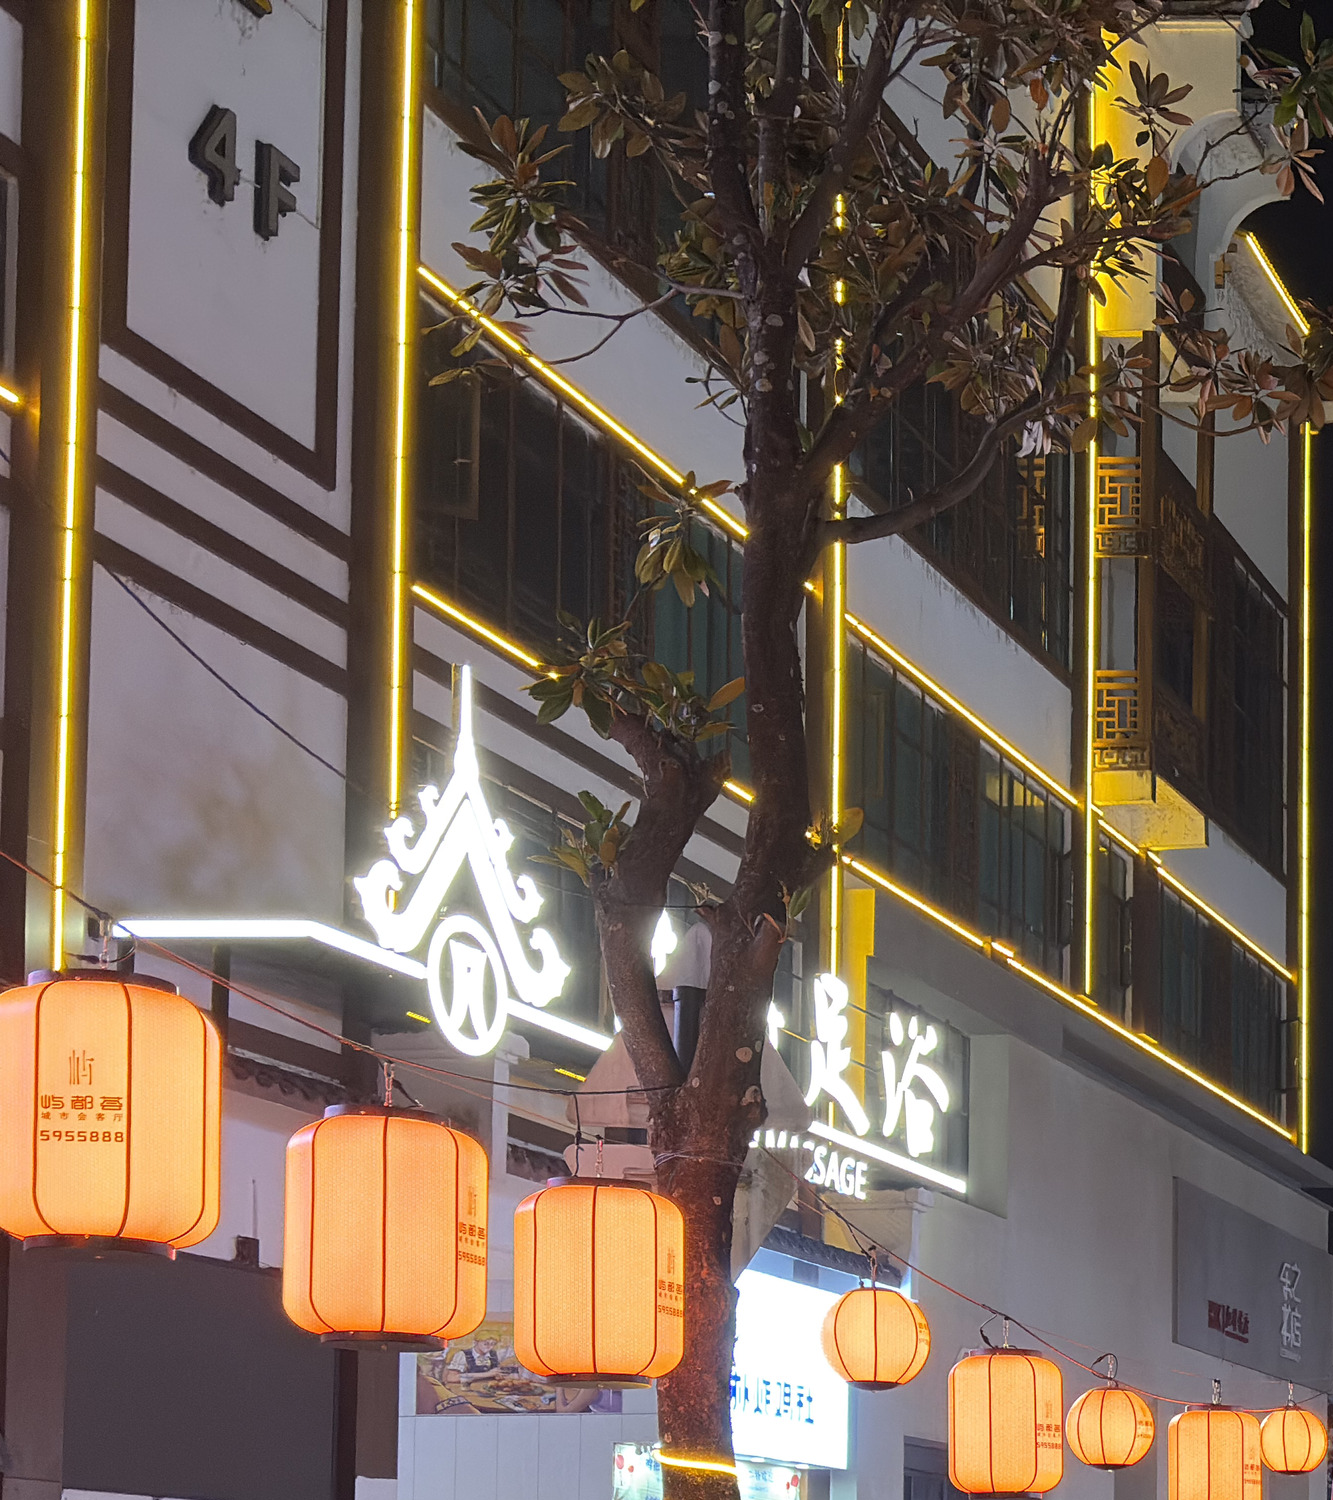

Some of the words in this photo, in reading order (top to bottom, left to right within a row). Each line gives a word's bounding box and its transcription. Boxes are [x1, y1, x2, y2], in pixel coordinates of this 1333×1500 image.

[188, 104, 300, 241] 4F
[767, 973, 950, 1158] 足浴
[40, 1130, 124, 1142] 5955888
[458, 1251, 486, 1266] 5955888
